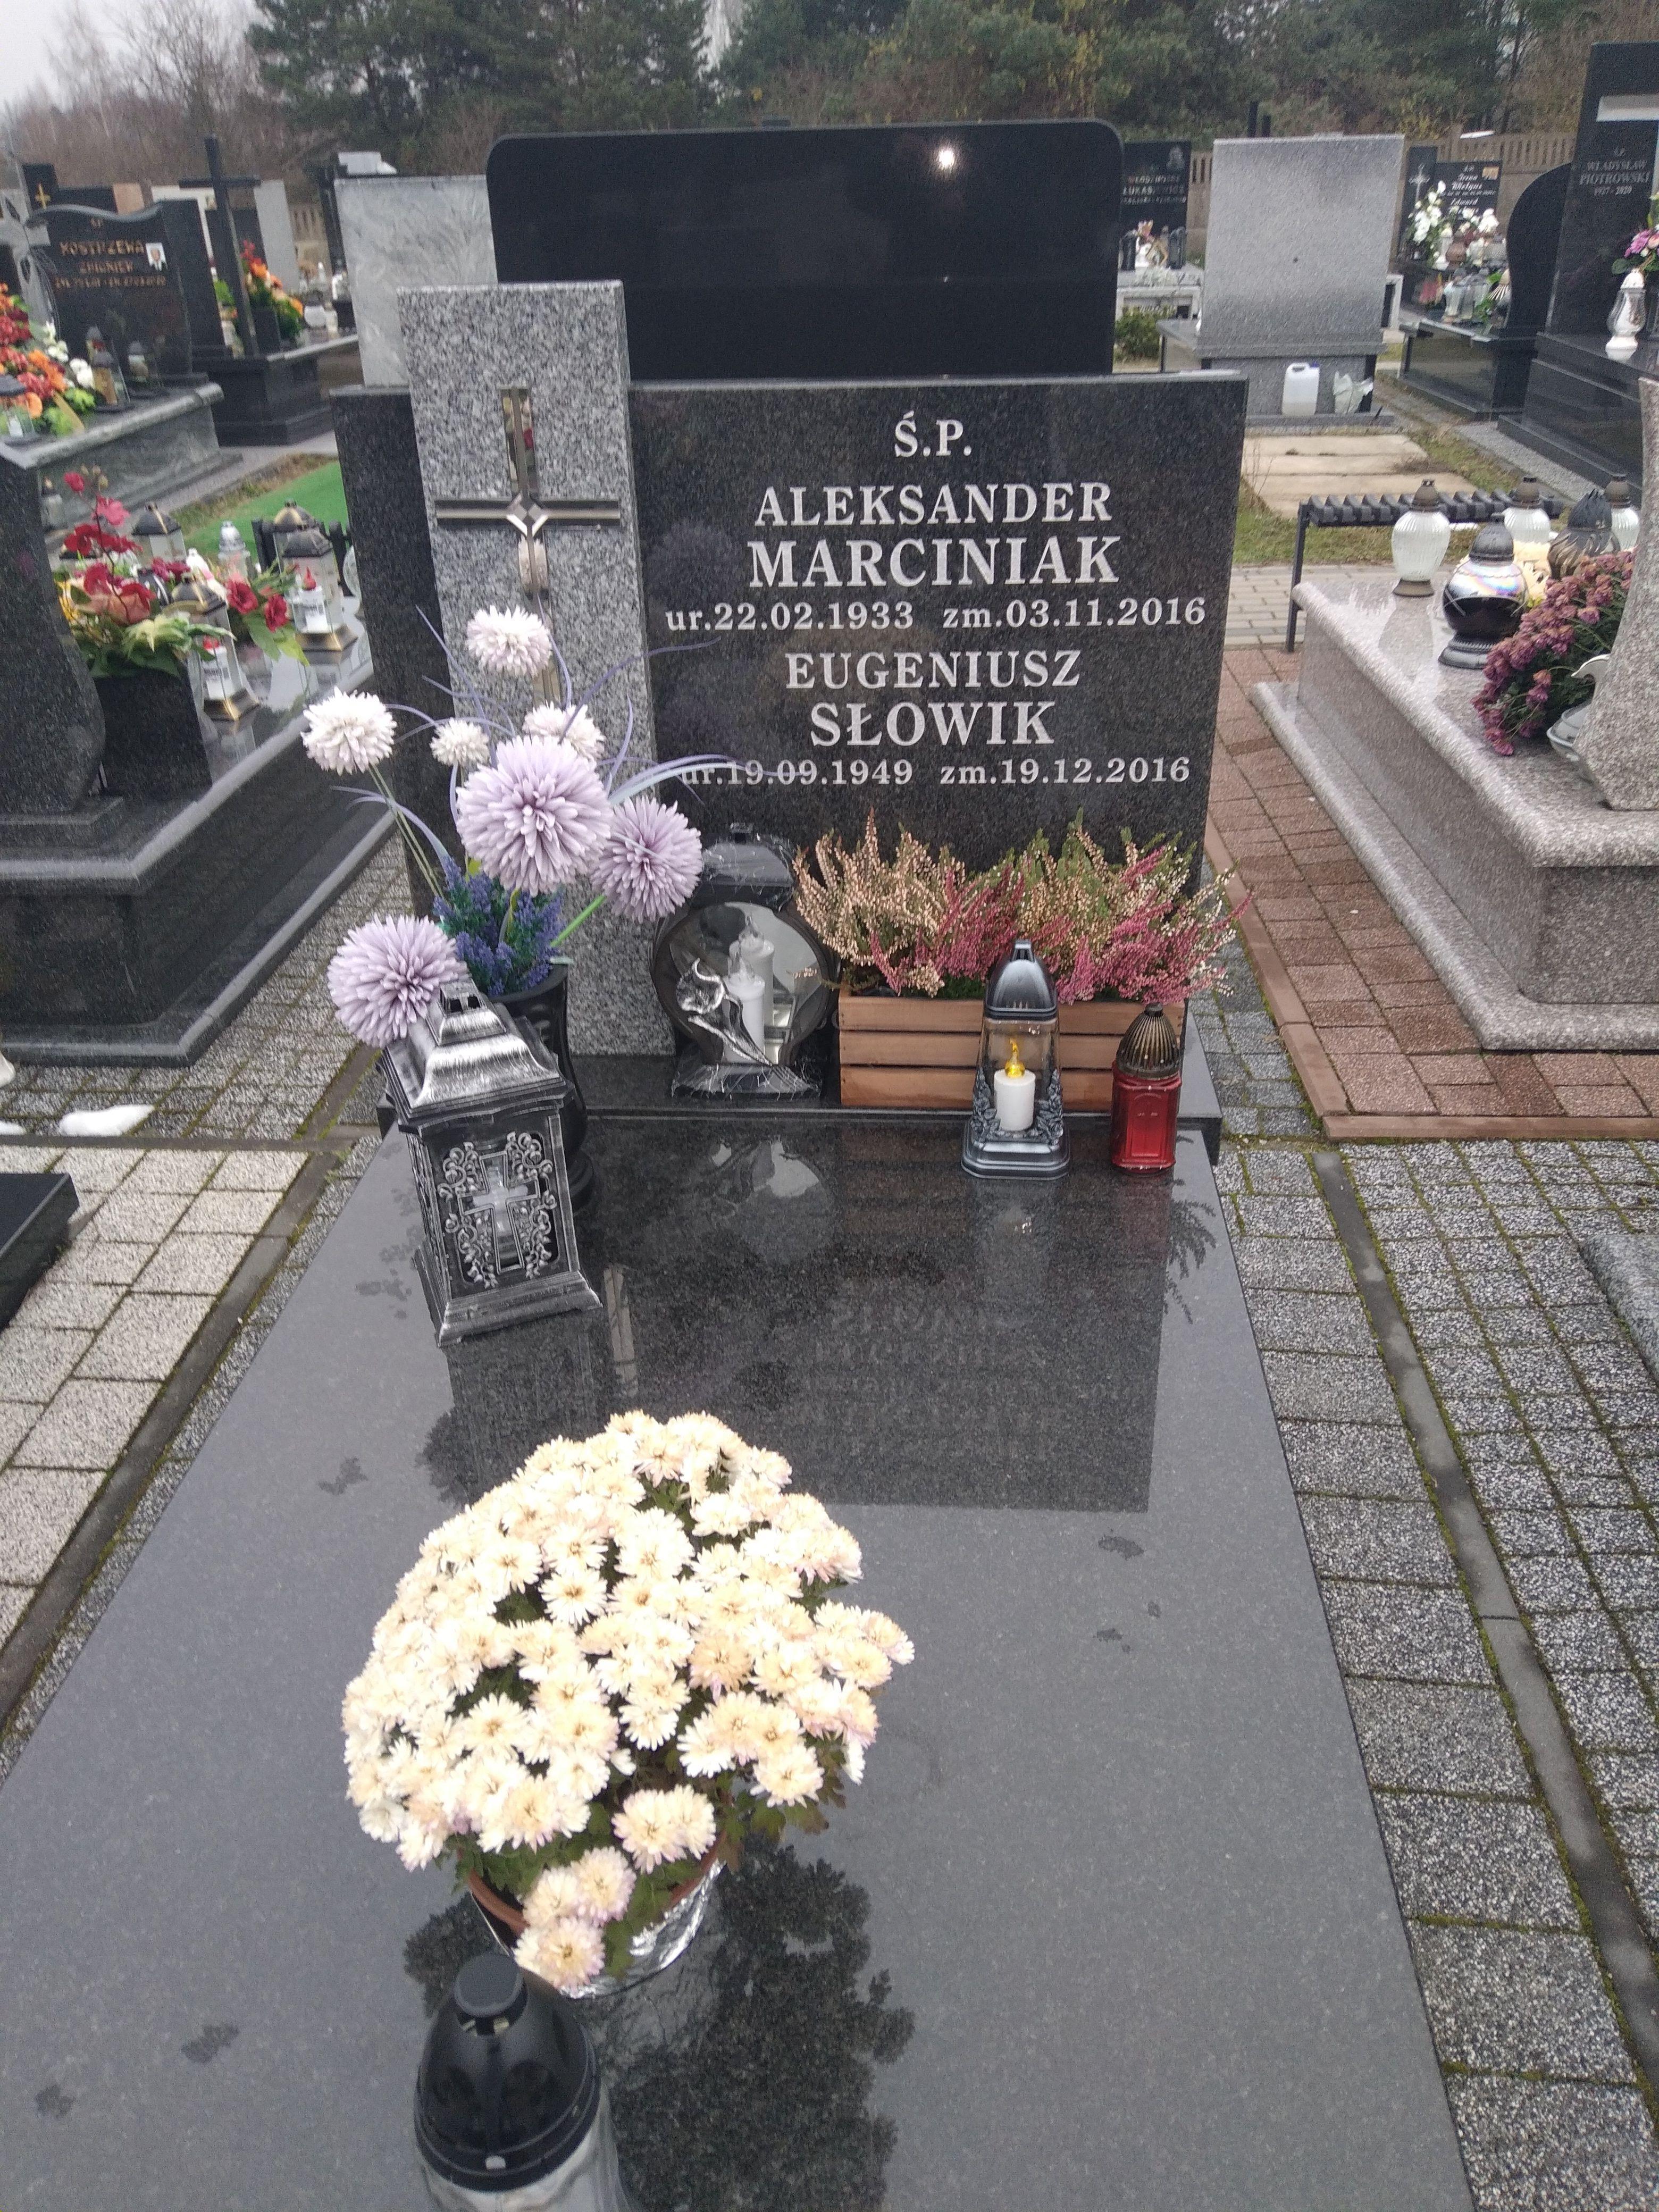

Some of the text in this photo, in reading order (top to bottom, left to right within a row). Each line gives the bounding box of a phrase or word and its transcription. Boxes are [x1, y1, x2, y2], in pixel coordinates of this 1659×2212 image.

[1579, 171, 1651, 185] PIOTROWSKI
[894, 410, 972, 457] Ś.P.
[754, 481, 1112, 527] ALEKSANDER
[747, 535, 1121, 588] MARCINIAK
[665, 597, 1206, 631] ur.22.02.1933 zm.03.11.2016
[784, 649, 1082, 690] EUGENIUSZ
[810, 701, 1056, 747] SŁOWIK
[680, 756, 1191, 785] ur.19.09.1949 zm.19.12.2016
